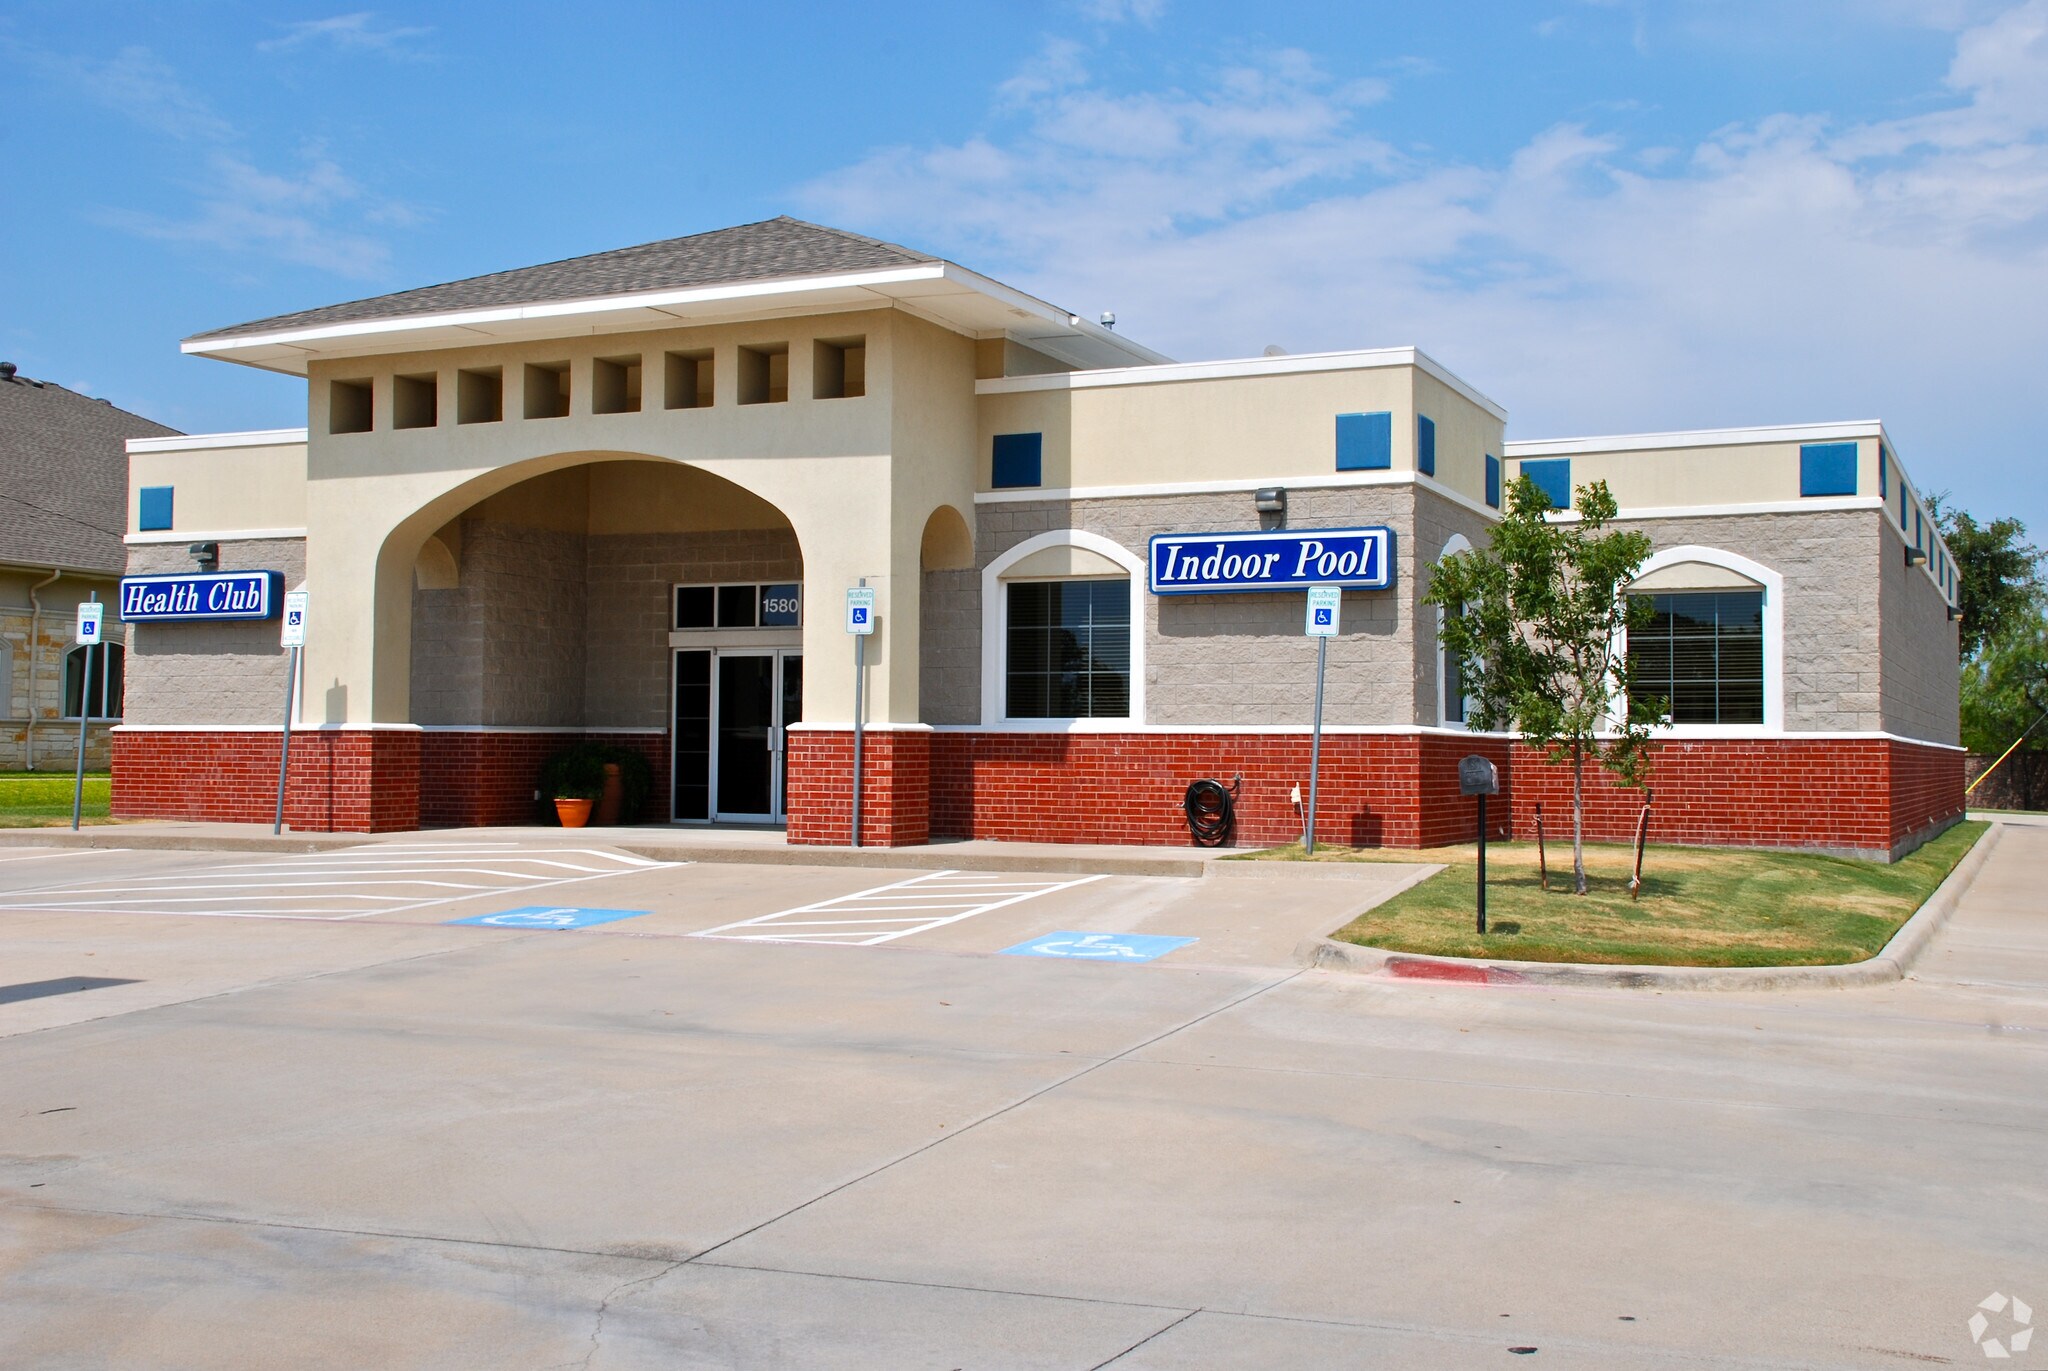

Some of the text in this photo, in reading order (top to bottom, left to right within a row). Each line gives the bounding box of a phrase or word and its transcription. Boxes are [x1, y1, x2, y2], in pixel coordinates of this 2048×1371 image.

[1160, 538, 1373, 581] Indoor Pool
[124, 581, 260, 614] Health Club
[763, 599, 798, 613] 1580
